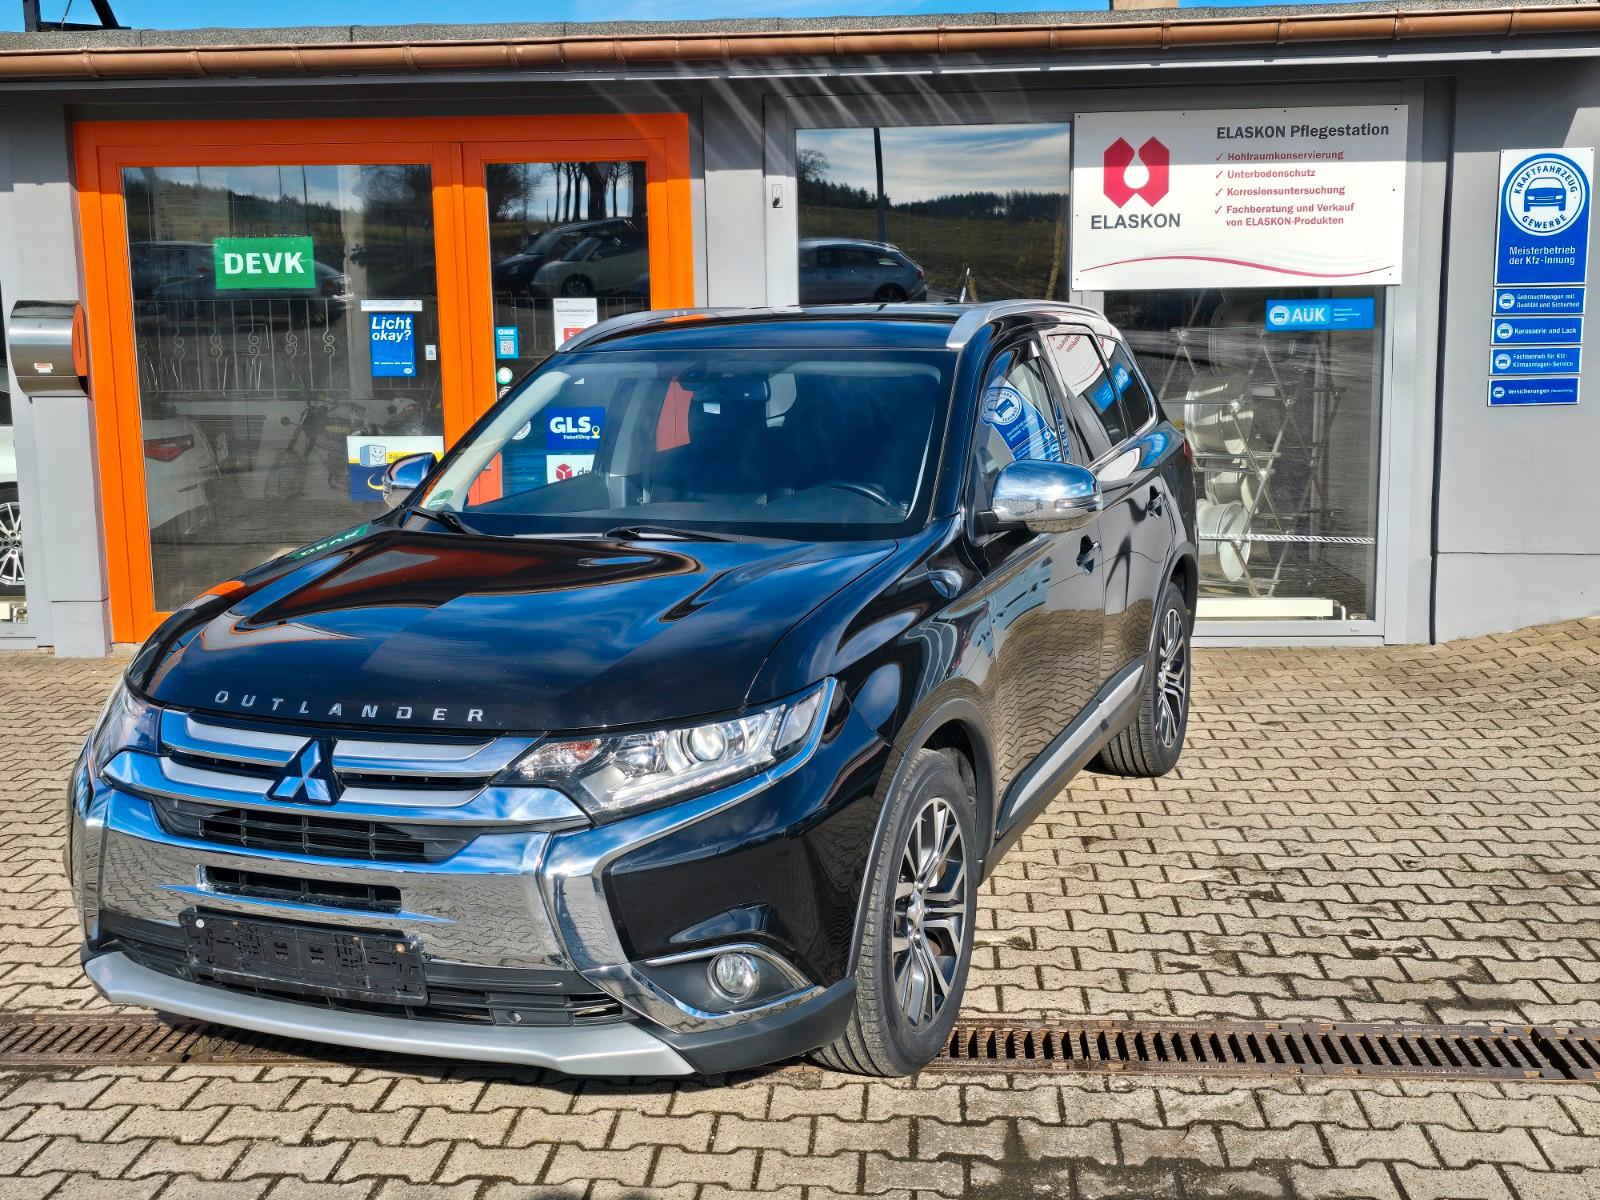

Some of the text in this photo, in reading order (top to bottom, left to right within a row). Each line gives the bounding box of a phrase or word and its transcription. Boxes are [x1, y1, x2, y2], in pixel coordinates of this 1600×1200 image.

[1216, 123, 1390, 140] ELASKON Pflegestation
[1227, 151, 1345, 161] Hohlraumkonservierung
[1227, 169, 1316, 179] Unterbodenschutz
[1513, 165, 1578, 195] KRAFTFAHRZEUG
[1227, 186, 1346, 197] Korrosionsuntersuchung
[1226, 203, 1356, 215] Fachberatung und Verkauf
[1090, 213, 1181, 230] ELASKON
[1226, 216, 1345, 227] von ELASKON-Produkten
[1521, 213, 1568, 229] GEWERBE
[1509, 246, 1576, 255] Meisterbetrieb
[224, 252, 305, 275] DEVK
[1525, 256, 1575, 266] Kfz-Innung
[371, 317, 411, 330] Licht
[372, 330, 411, 342] okay?
[550, 416, 591, 434] GLS
[214, 690, 483, 722] OUTLANDER
